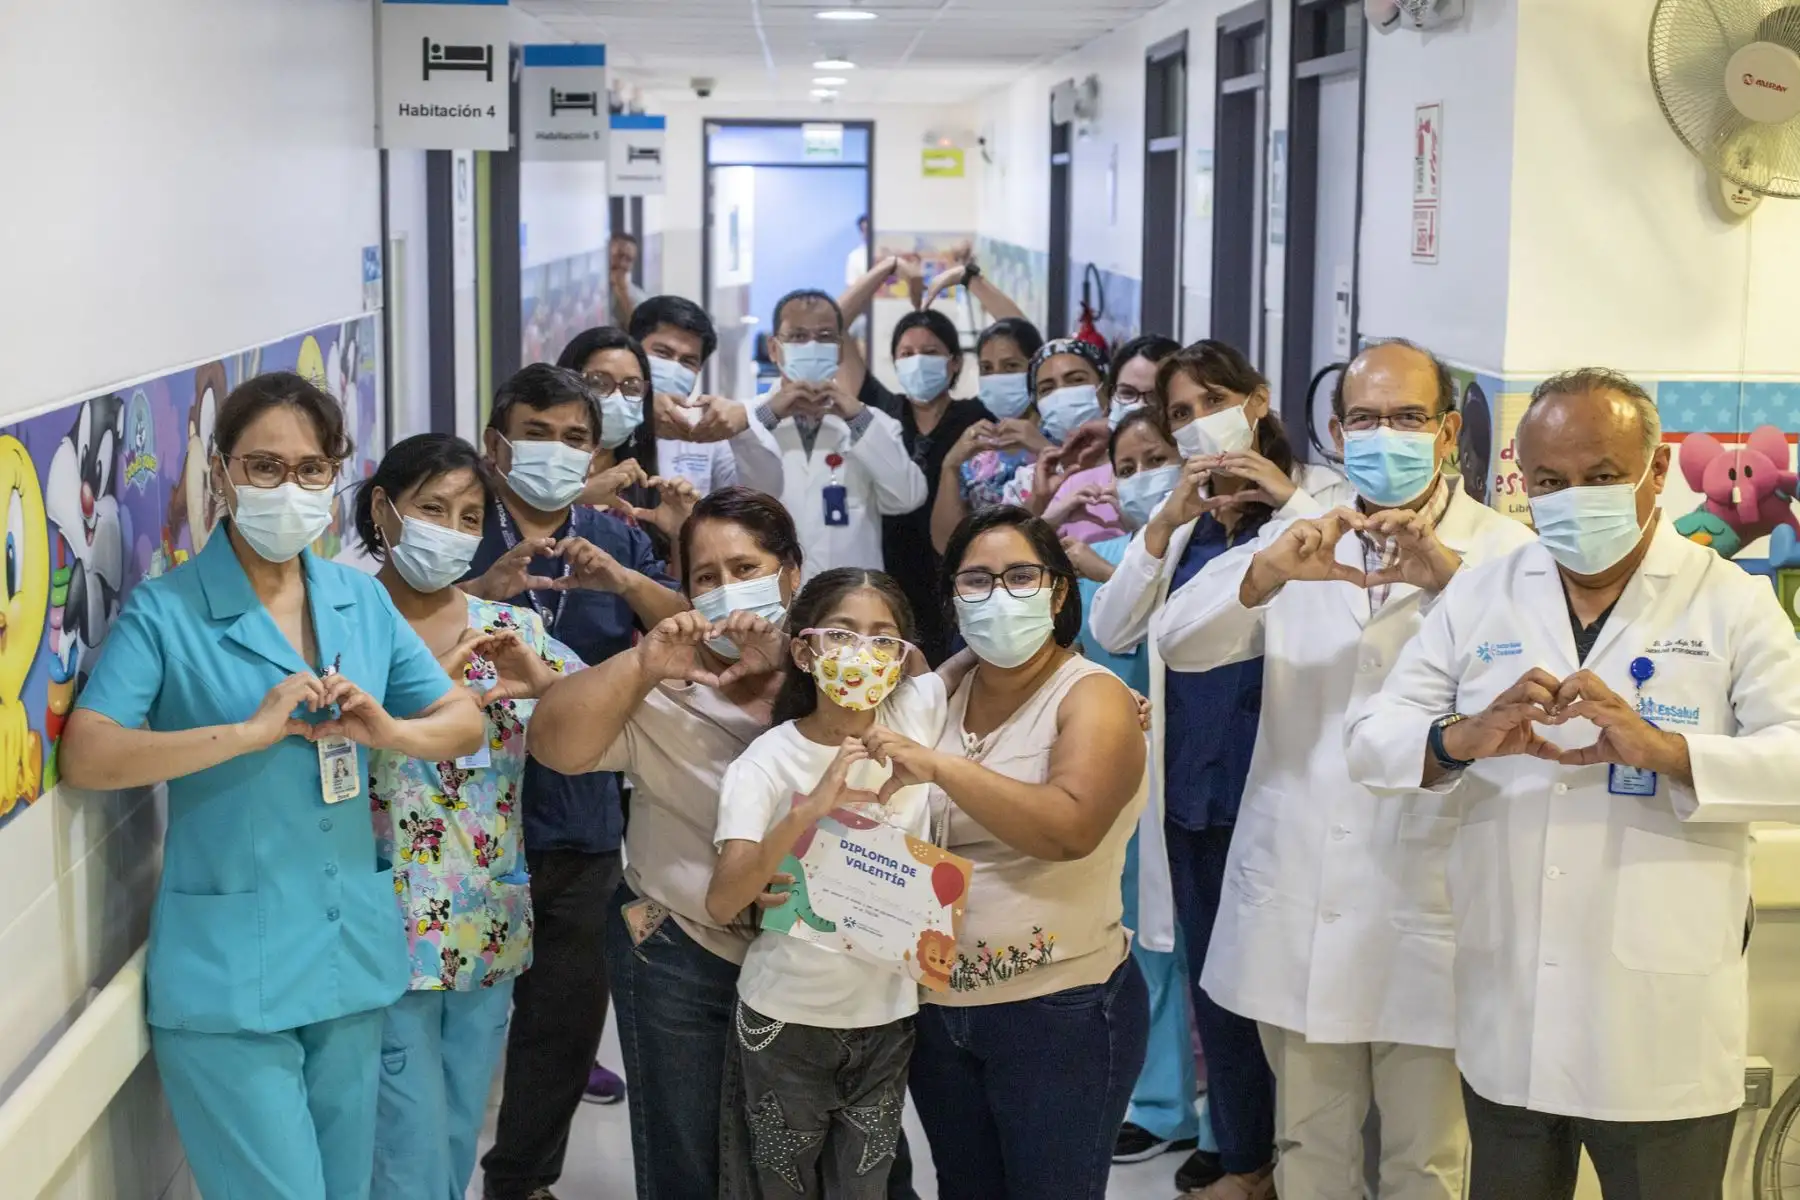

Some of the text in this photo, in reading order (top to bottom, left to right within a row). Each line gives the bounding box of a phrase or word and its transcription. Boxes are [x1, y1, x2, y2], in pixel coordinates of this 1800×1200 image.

[399, 103, 496, 118] Habitación 4
[1658, 704, 1699, 719] EsSalud
[840, 839, 917, 878] DIPLOMA DE
[846, 856, 906, 888] VALENTÍA
